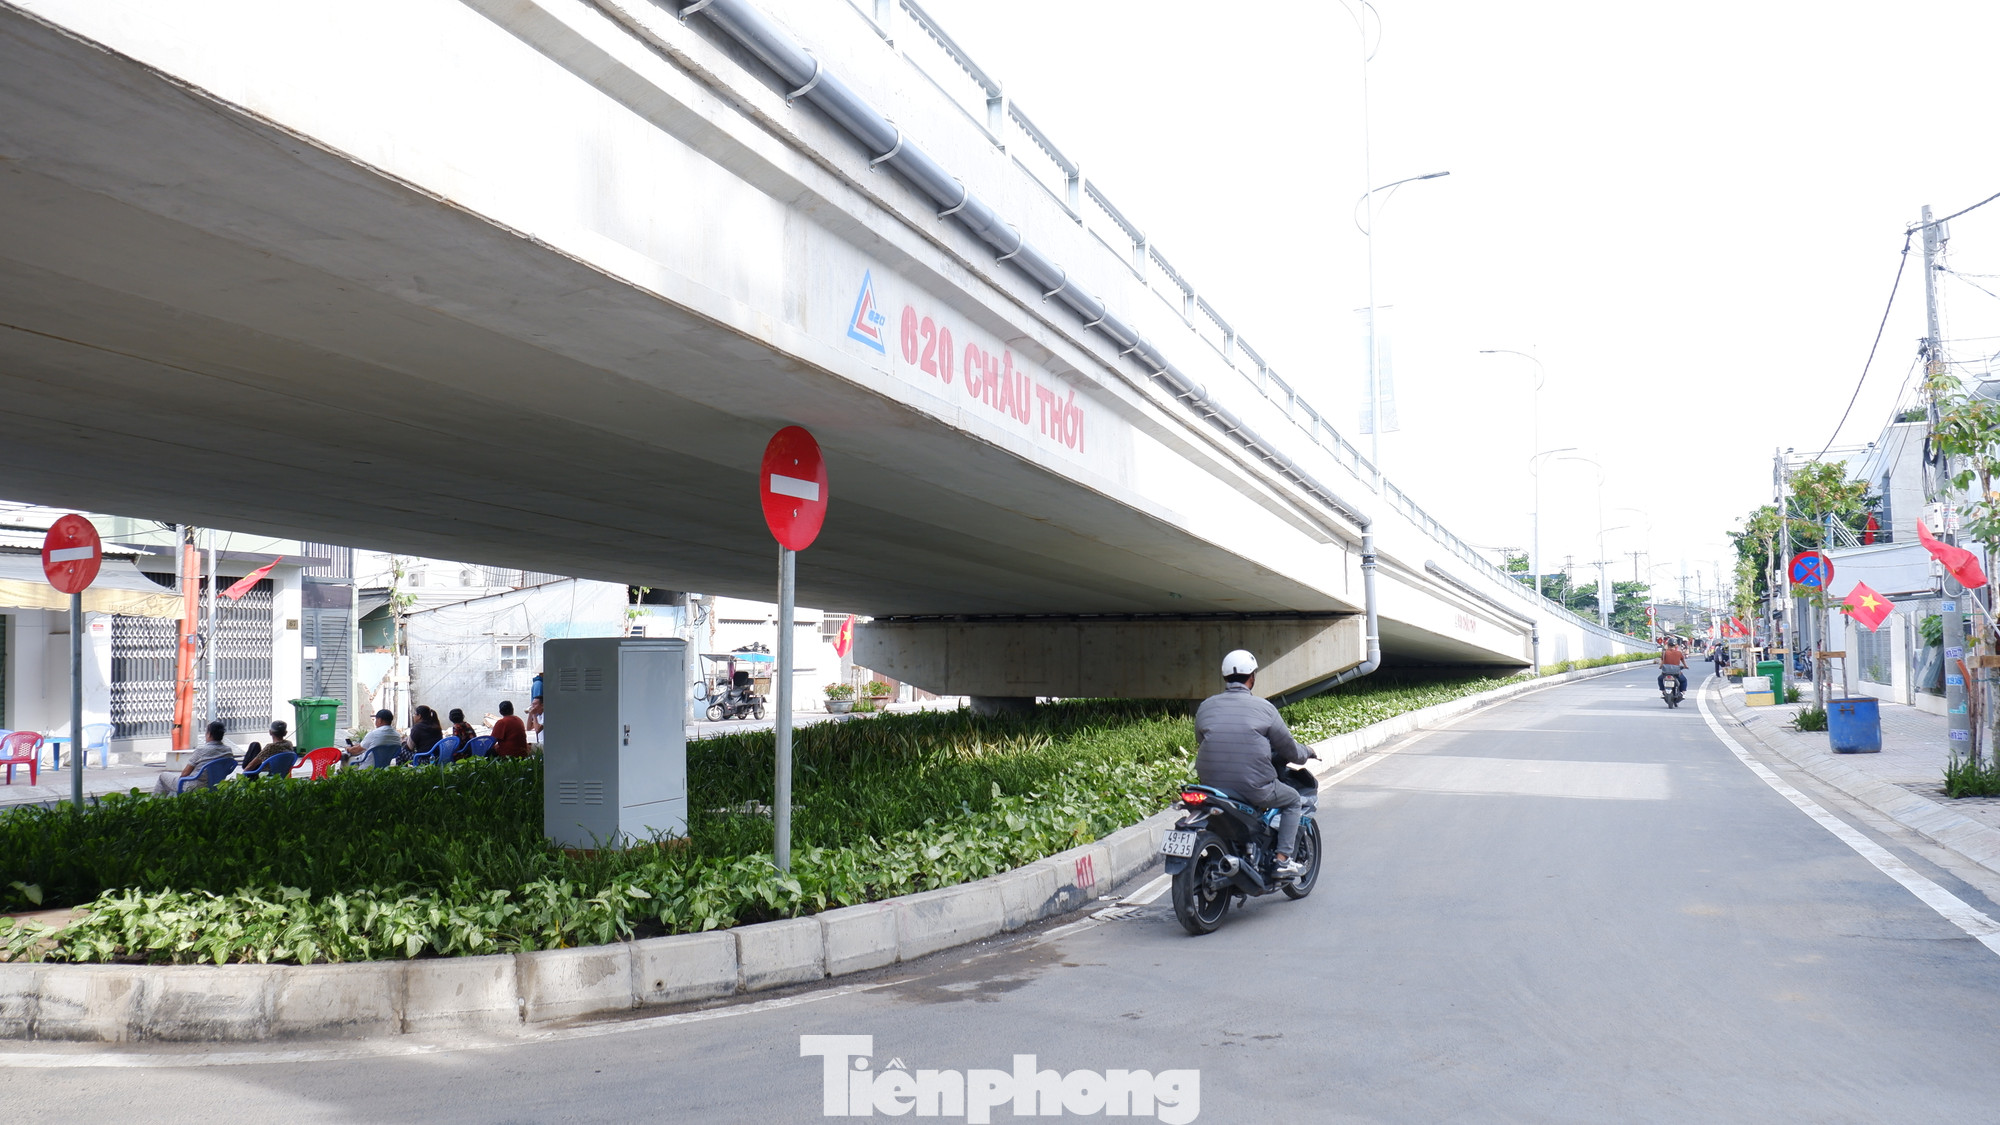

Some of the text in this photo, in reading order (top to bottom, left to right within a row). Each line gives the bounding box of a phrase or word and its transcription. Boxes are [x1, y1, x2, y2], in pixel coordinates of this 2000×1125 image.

[901, 305, 1084, 454] 620 CHÂU THỚI
[1162, 842, 1191, 855] 452.35
